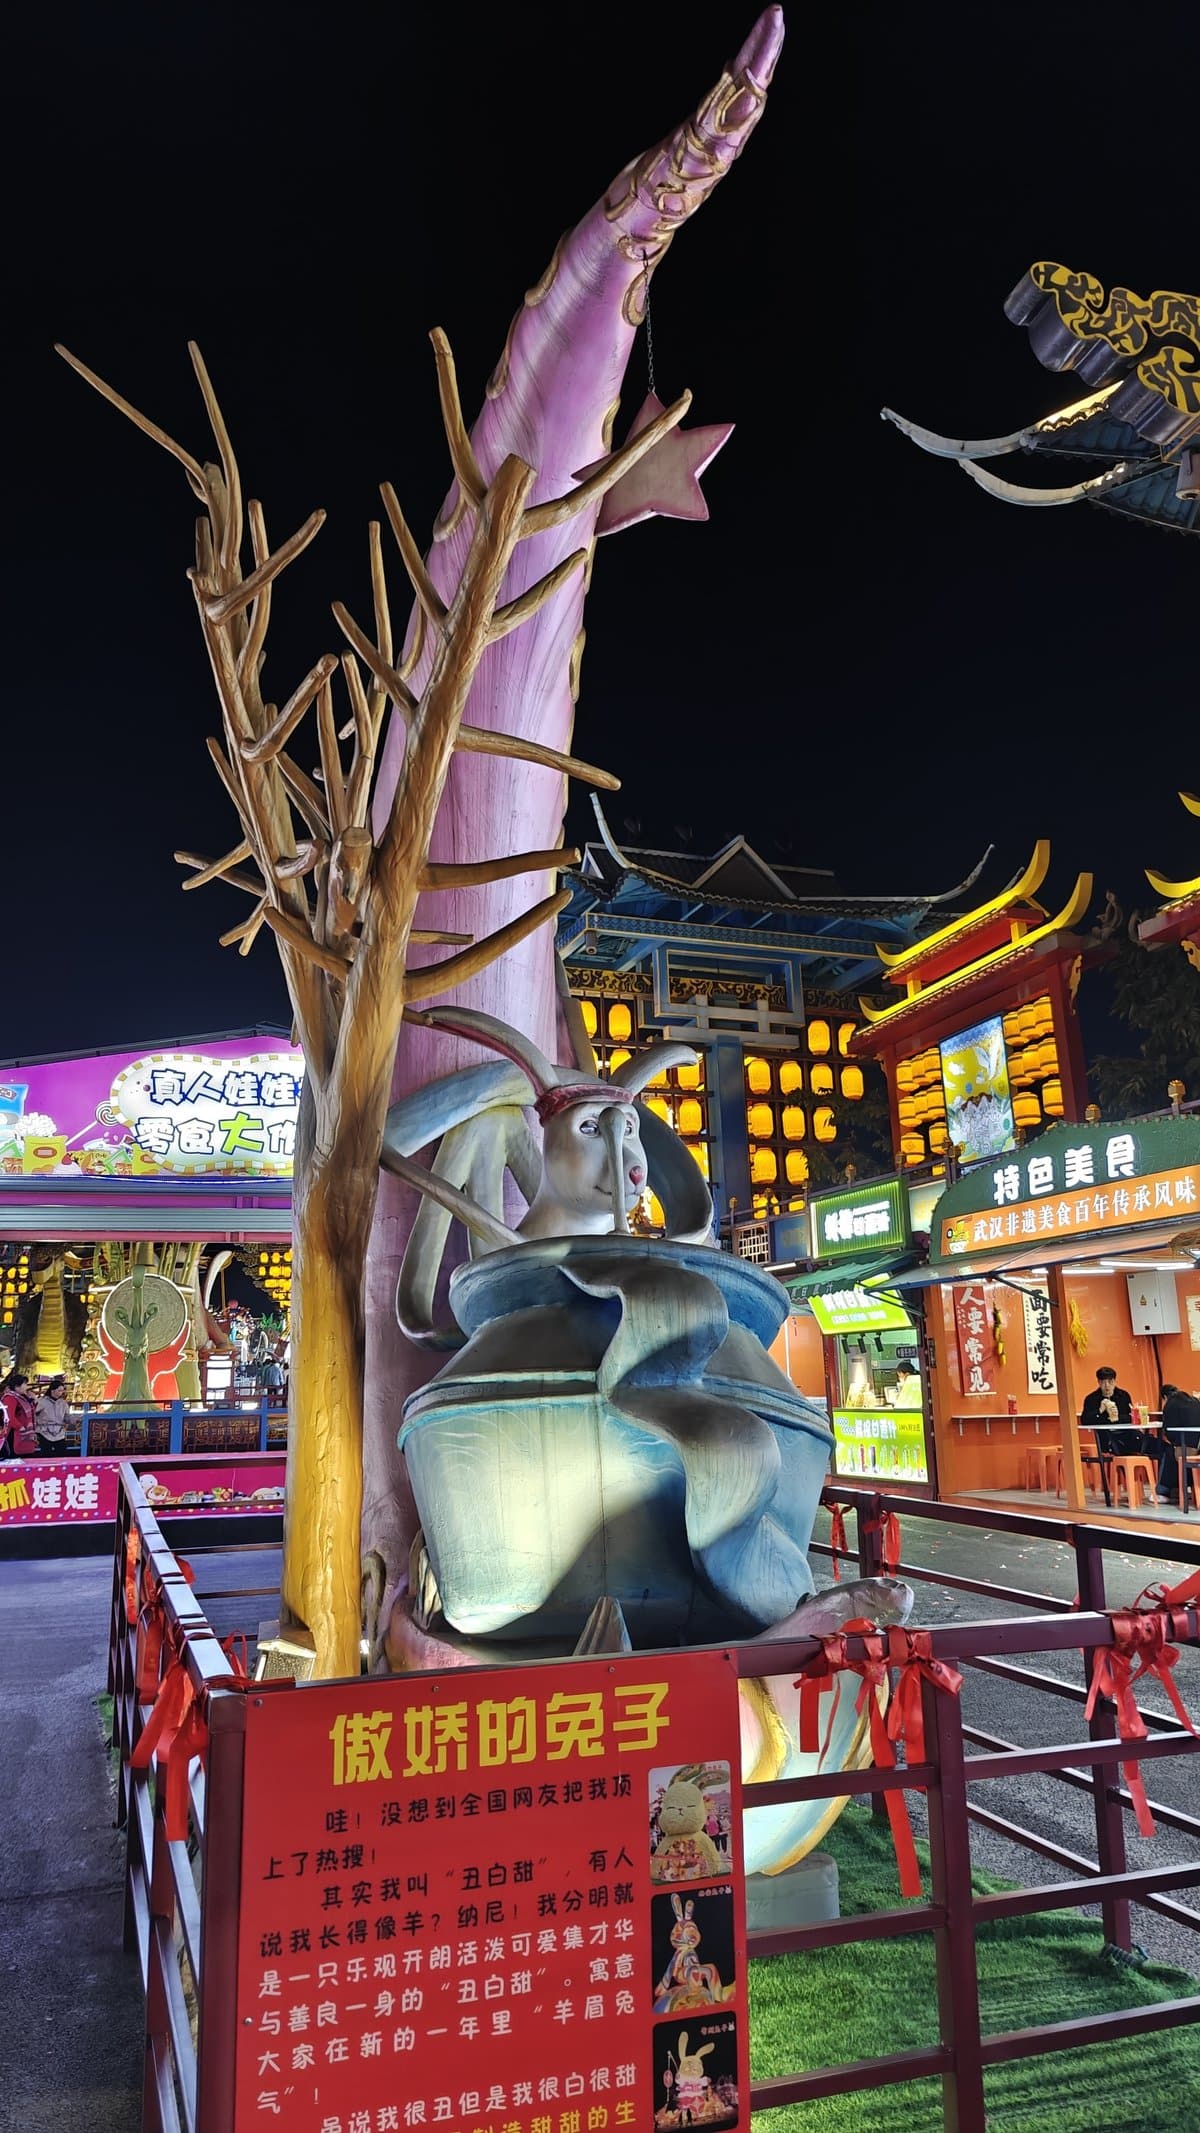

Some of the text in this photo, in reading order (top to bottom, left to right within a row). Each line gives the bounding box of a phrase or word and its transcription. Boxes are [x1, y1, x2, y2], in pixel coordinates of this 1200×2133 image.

[150, 1069, 303, 1107] 真人娃娃
[973, 1175, 1197, 1242] 武汉非遗美食百年传承风味
[992, 1133, 1136, 1205] 特色美食
[960, 1287, 991, 1393] 人要常见
[1029, 1288, 1055, 1391] 面要常吃
[328, 1682, 670, 1786] 傲娇的兔子
[258, 1918, 635, 1999] 是一只乐观开朗活泼可爱集才华
